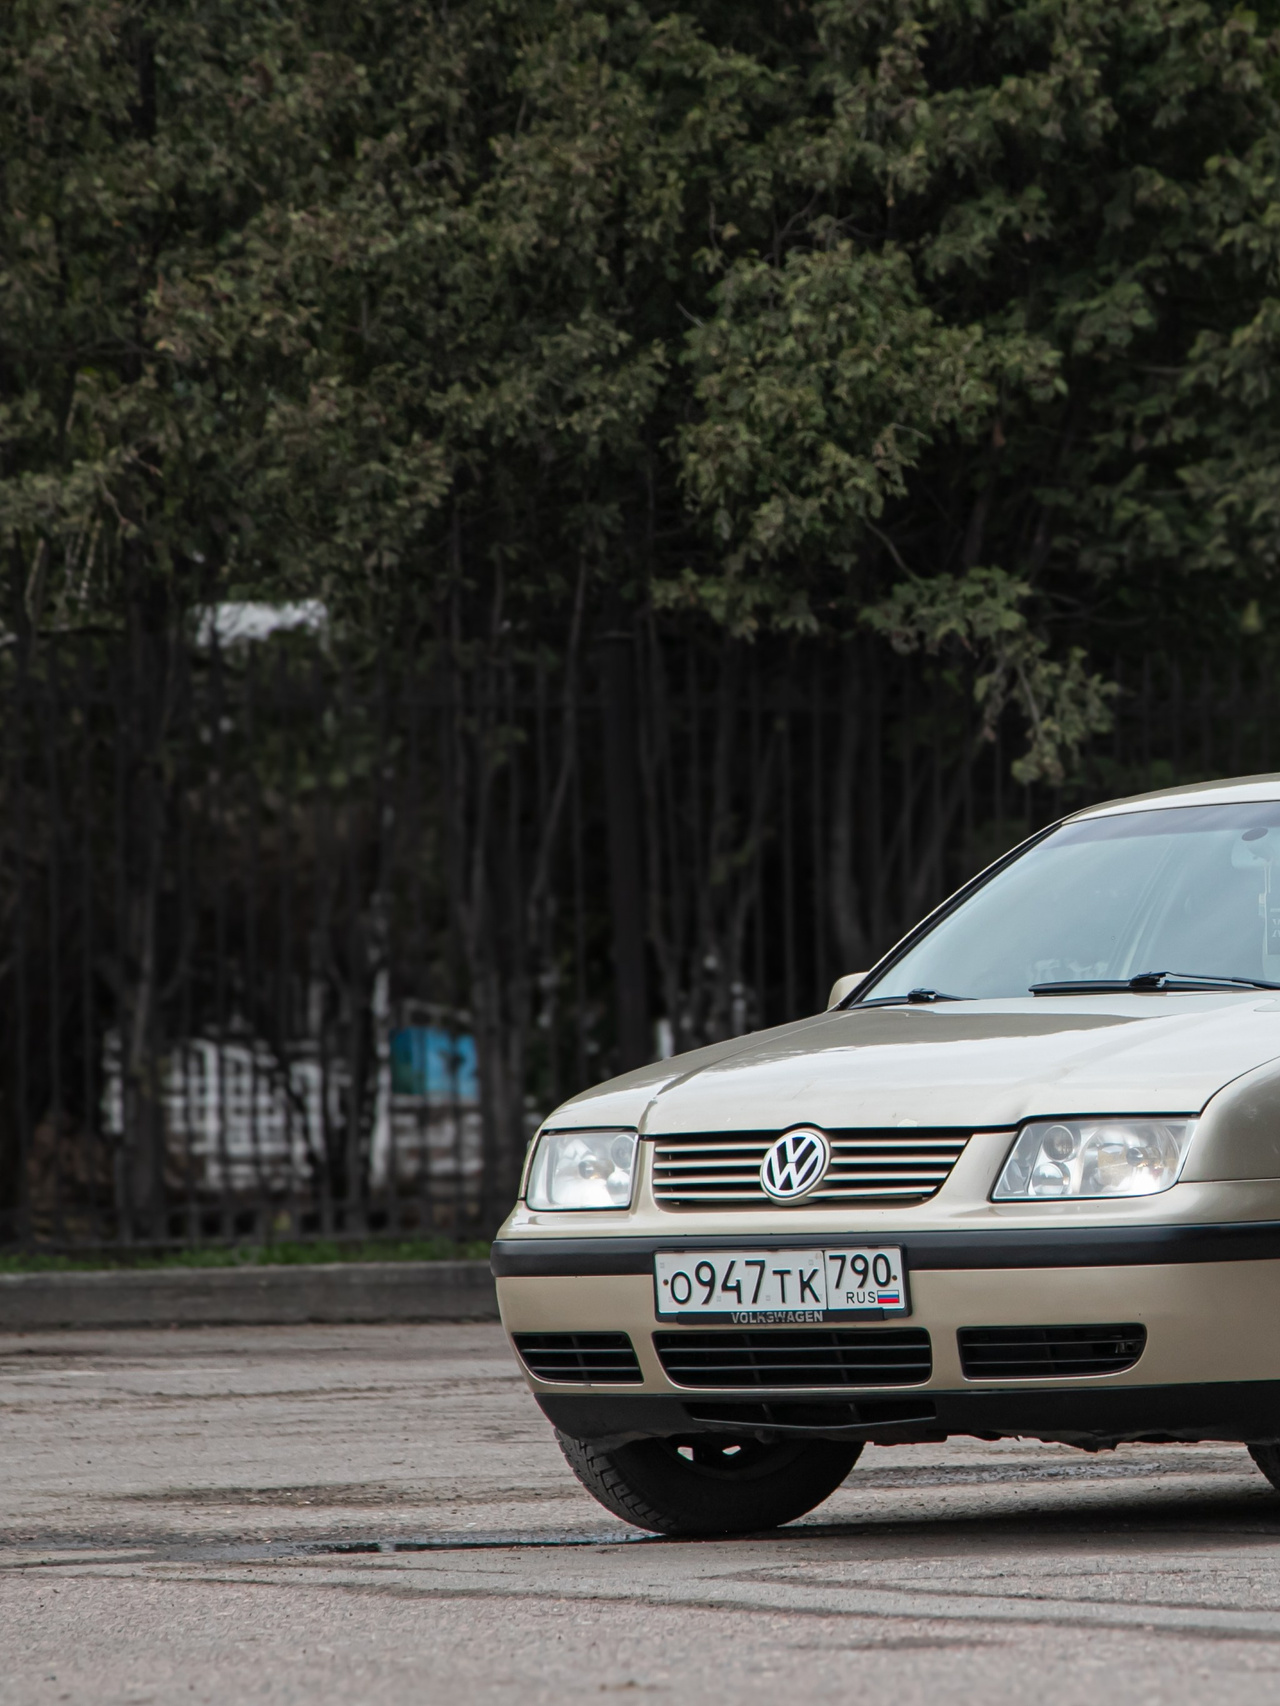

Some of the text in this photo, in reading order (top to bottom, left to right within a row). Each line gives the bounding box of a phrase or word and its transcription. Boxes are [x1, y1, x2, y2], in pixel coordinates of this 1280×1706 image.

[763, 1131, 825, 1197] VW
[670, 1253, 892, 1305] O947TK 790
[845, 1291, 877, 1304] RUS
[731, 1311, 824, 1324] VOLKSWAGEN
